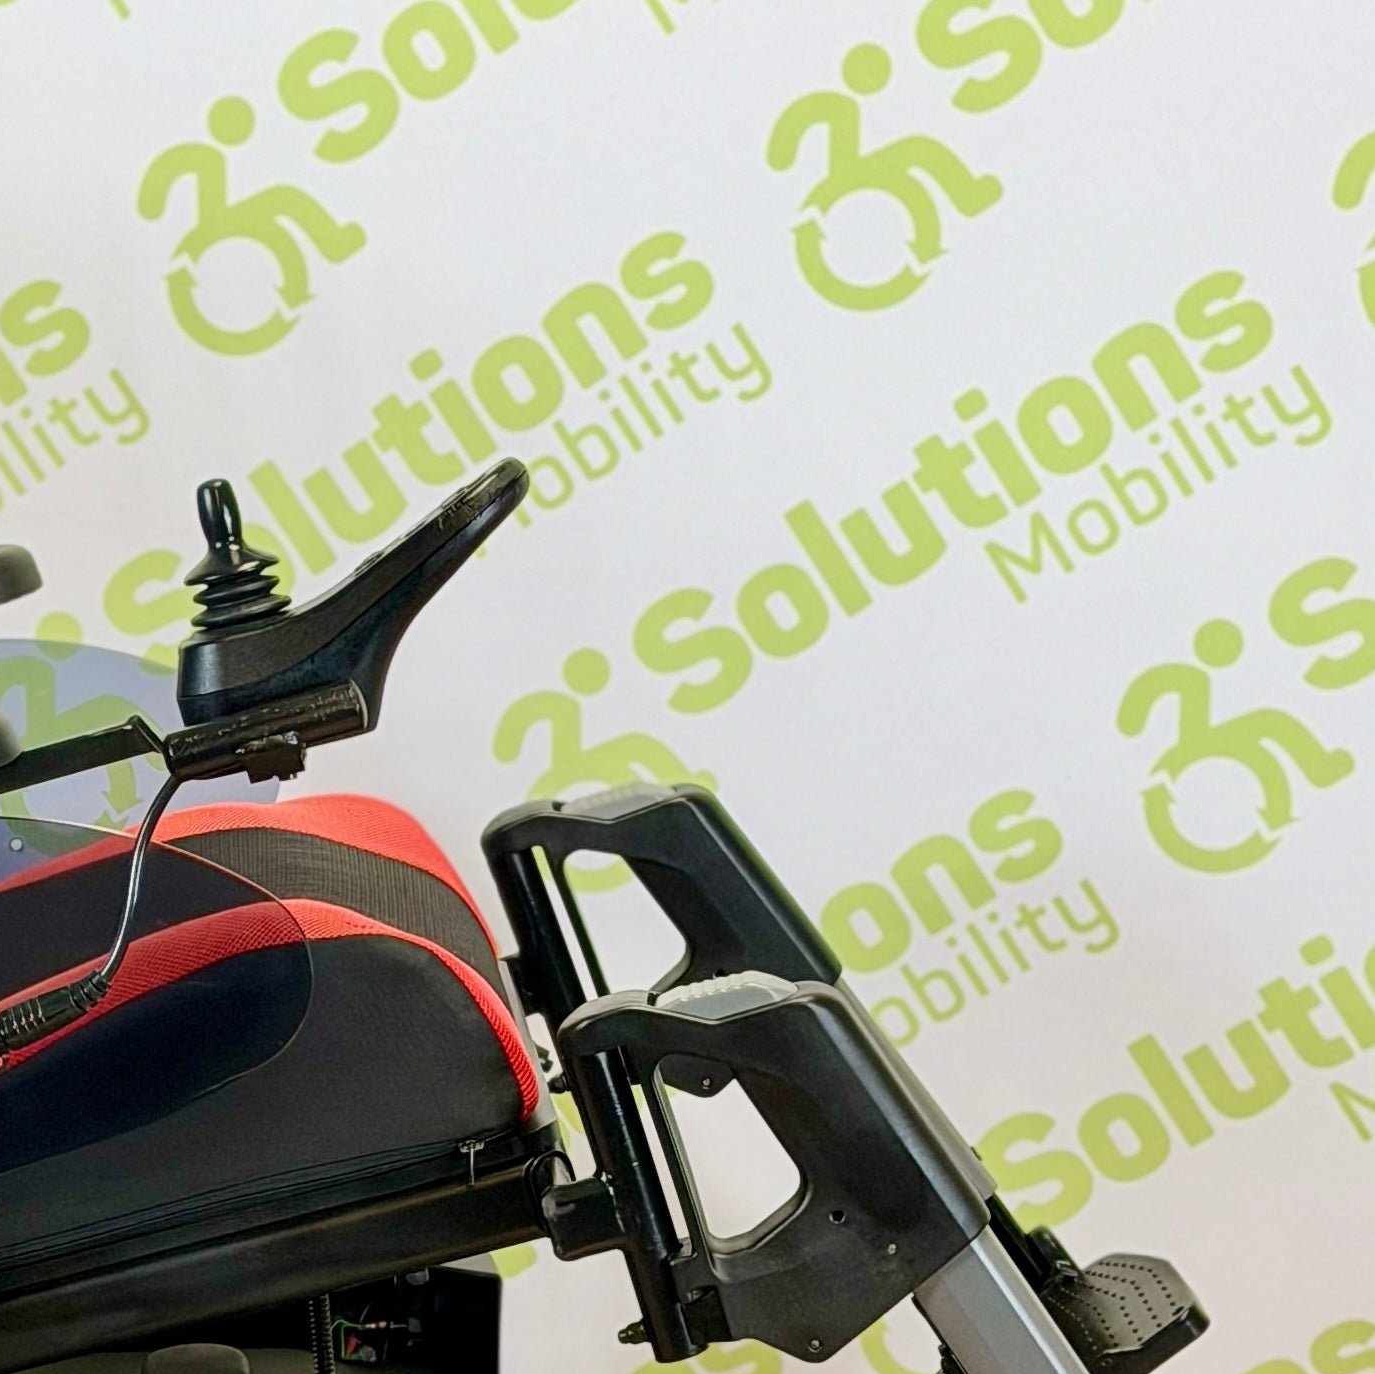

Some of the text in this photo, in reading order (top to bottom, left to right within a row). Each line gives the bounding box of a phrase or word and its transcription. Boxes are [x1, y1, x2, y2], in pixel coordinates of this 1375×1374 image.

[474, 324, 773, 560] obility
[629, 270, 1274, 715] Solutions
[983, 364, 1333, 604] Mobility
[867, 878, 1120, 1050] obility
[973, 934, 1375, 1236] Soluti
